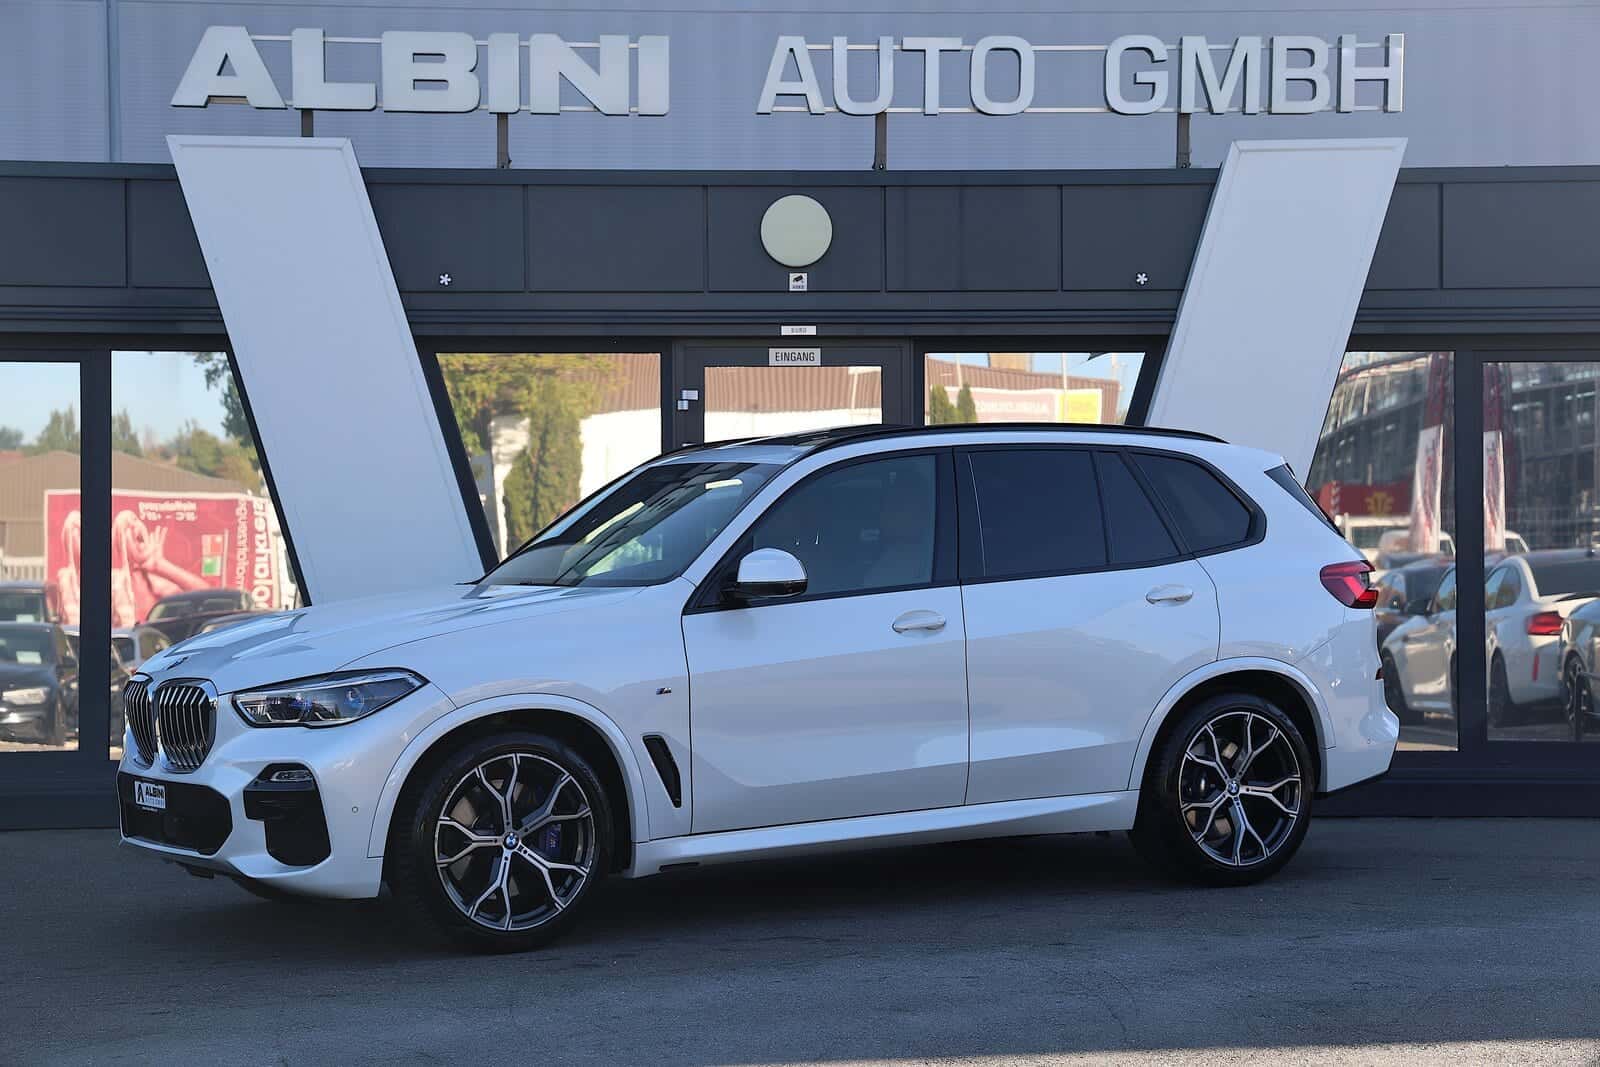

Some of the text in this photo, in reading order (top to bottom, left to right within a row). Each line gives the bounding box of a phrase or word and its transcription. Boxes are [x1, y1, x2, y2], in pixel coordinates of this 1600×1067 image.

[171, 26, 1405, 115] ALBINI AUTO GMBH
[775, 351, 815, 362] EINGANG
